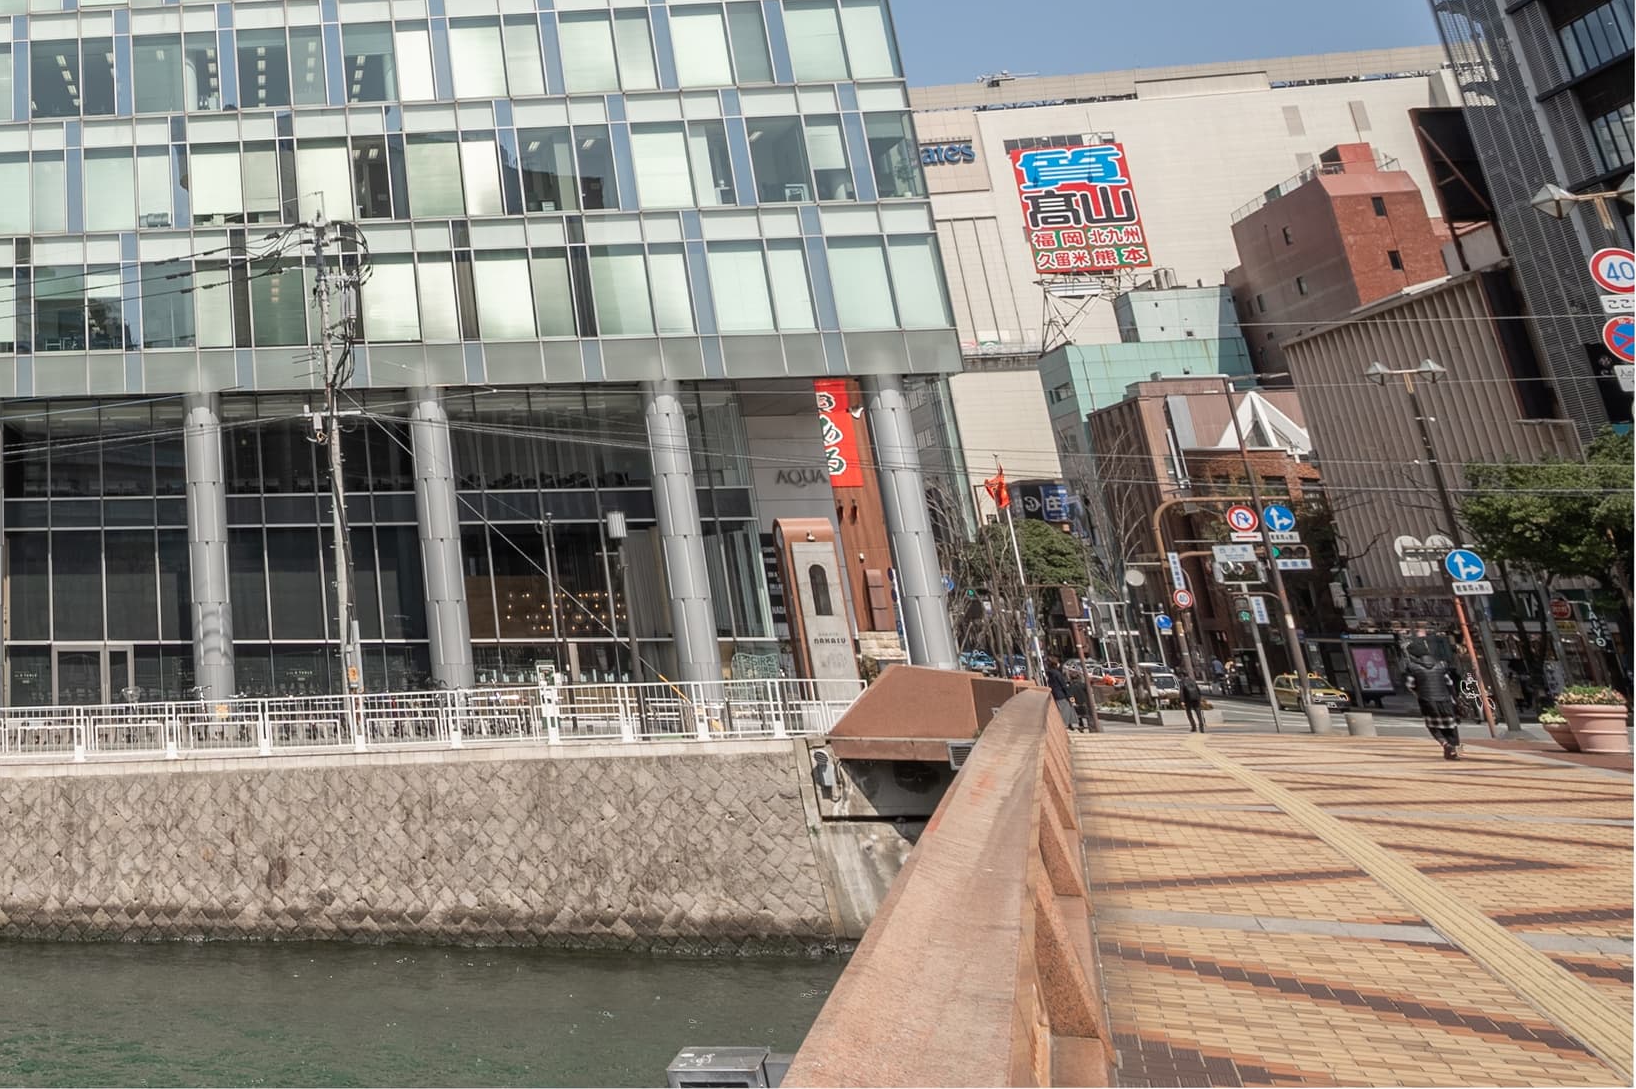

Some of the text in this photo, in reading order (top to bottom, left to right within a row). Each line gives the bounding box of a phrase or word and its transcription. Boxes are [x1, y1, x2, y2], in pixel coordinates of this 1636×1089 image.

[1016, 146, 1127, 190] 質
[1033, 226, 1141, 248] 福岡 北九州
[1037, 248, 1148, 269] 久留米 熊本
[1607, 261, 1634, 281] 40
[1607, 299, 1634, 310] ここ
[775, 470, 828, 487] AQUA
